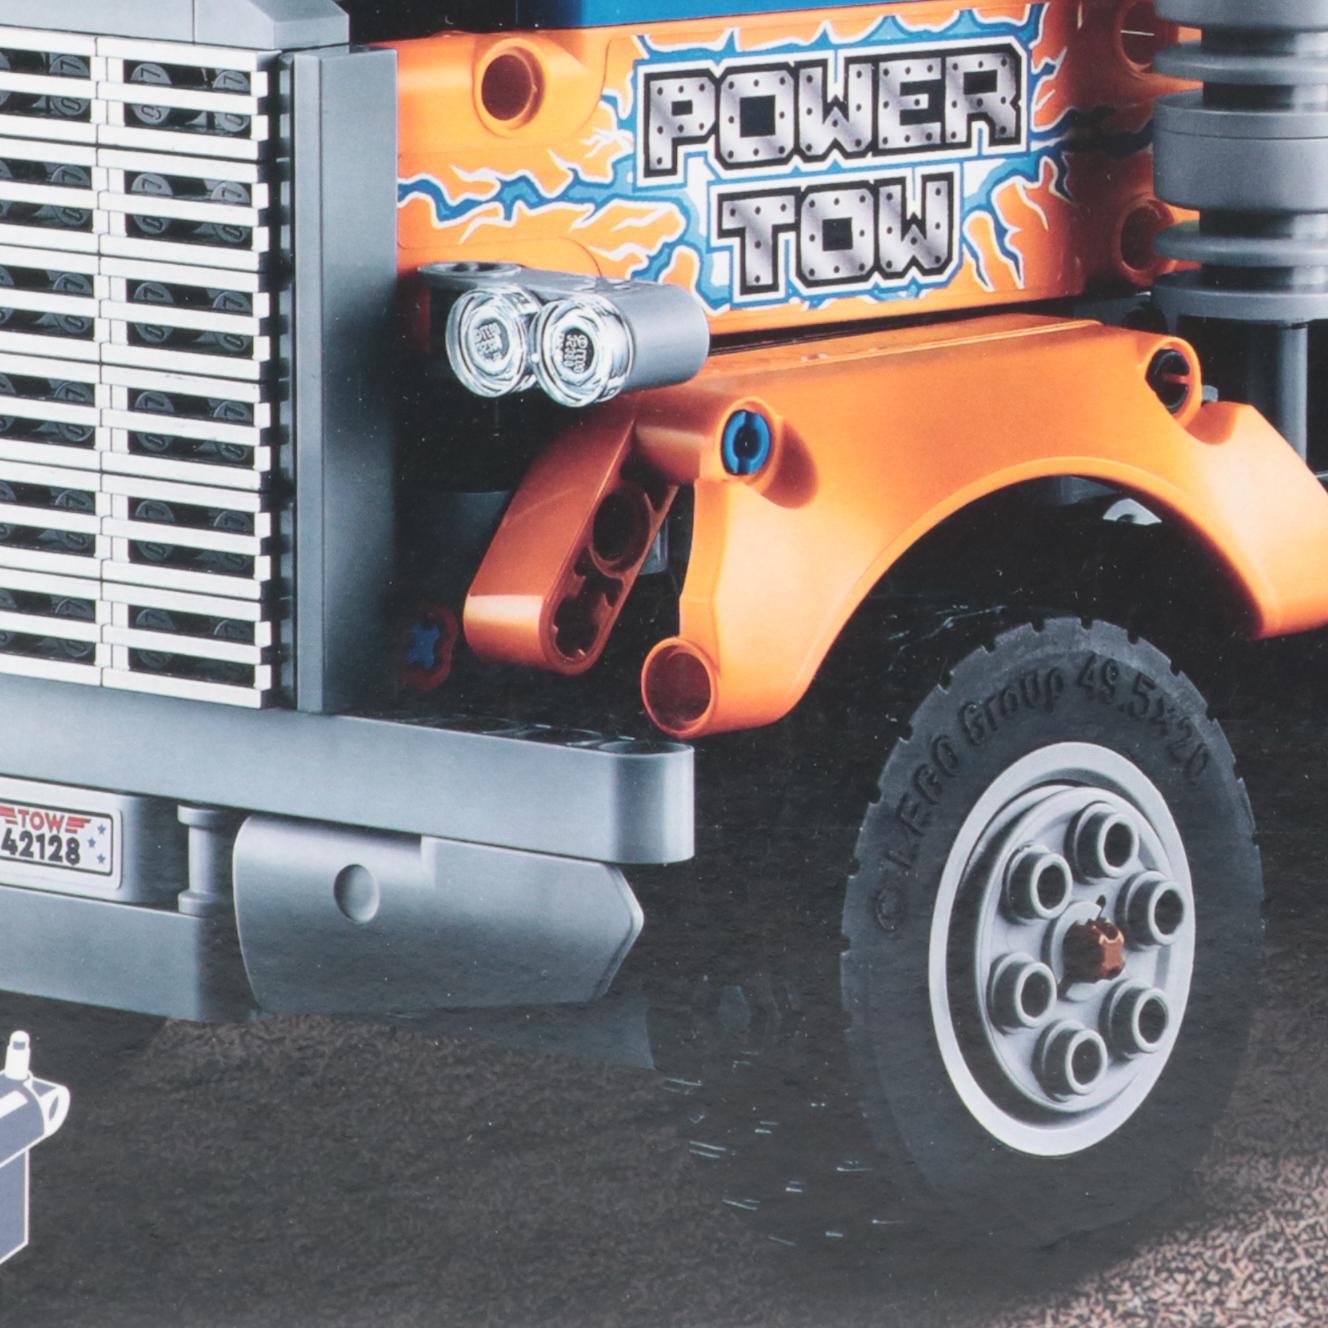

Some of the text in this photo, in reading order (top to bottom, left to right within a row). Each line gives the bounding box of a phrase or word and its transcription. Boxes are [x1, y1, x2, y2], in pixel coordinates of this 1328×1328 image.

[644, 45, 1025, 177] POWER
[717, 173, 954, 295] TOW
[957, 666, 1065, 746] Group
[1, 827, 80, 866] 42128
[18, 808, 65, 834] TOW
